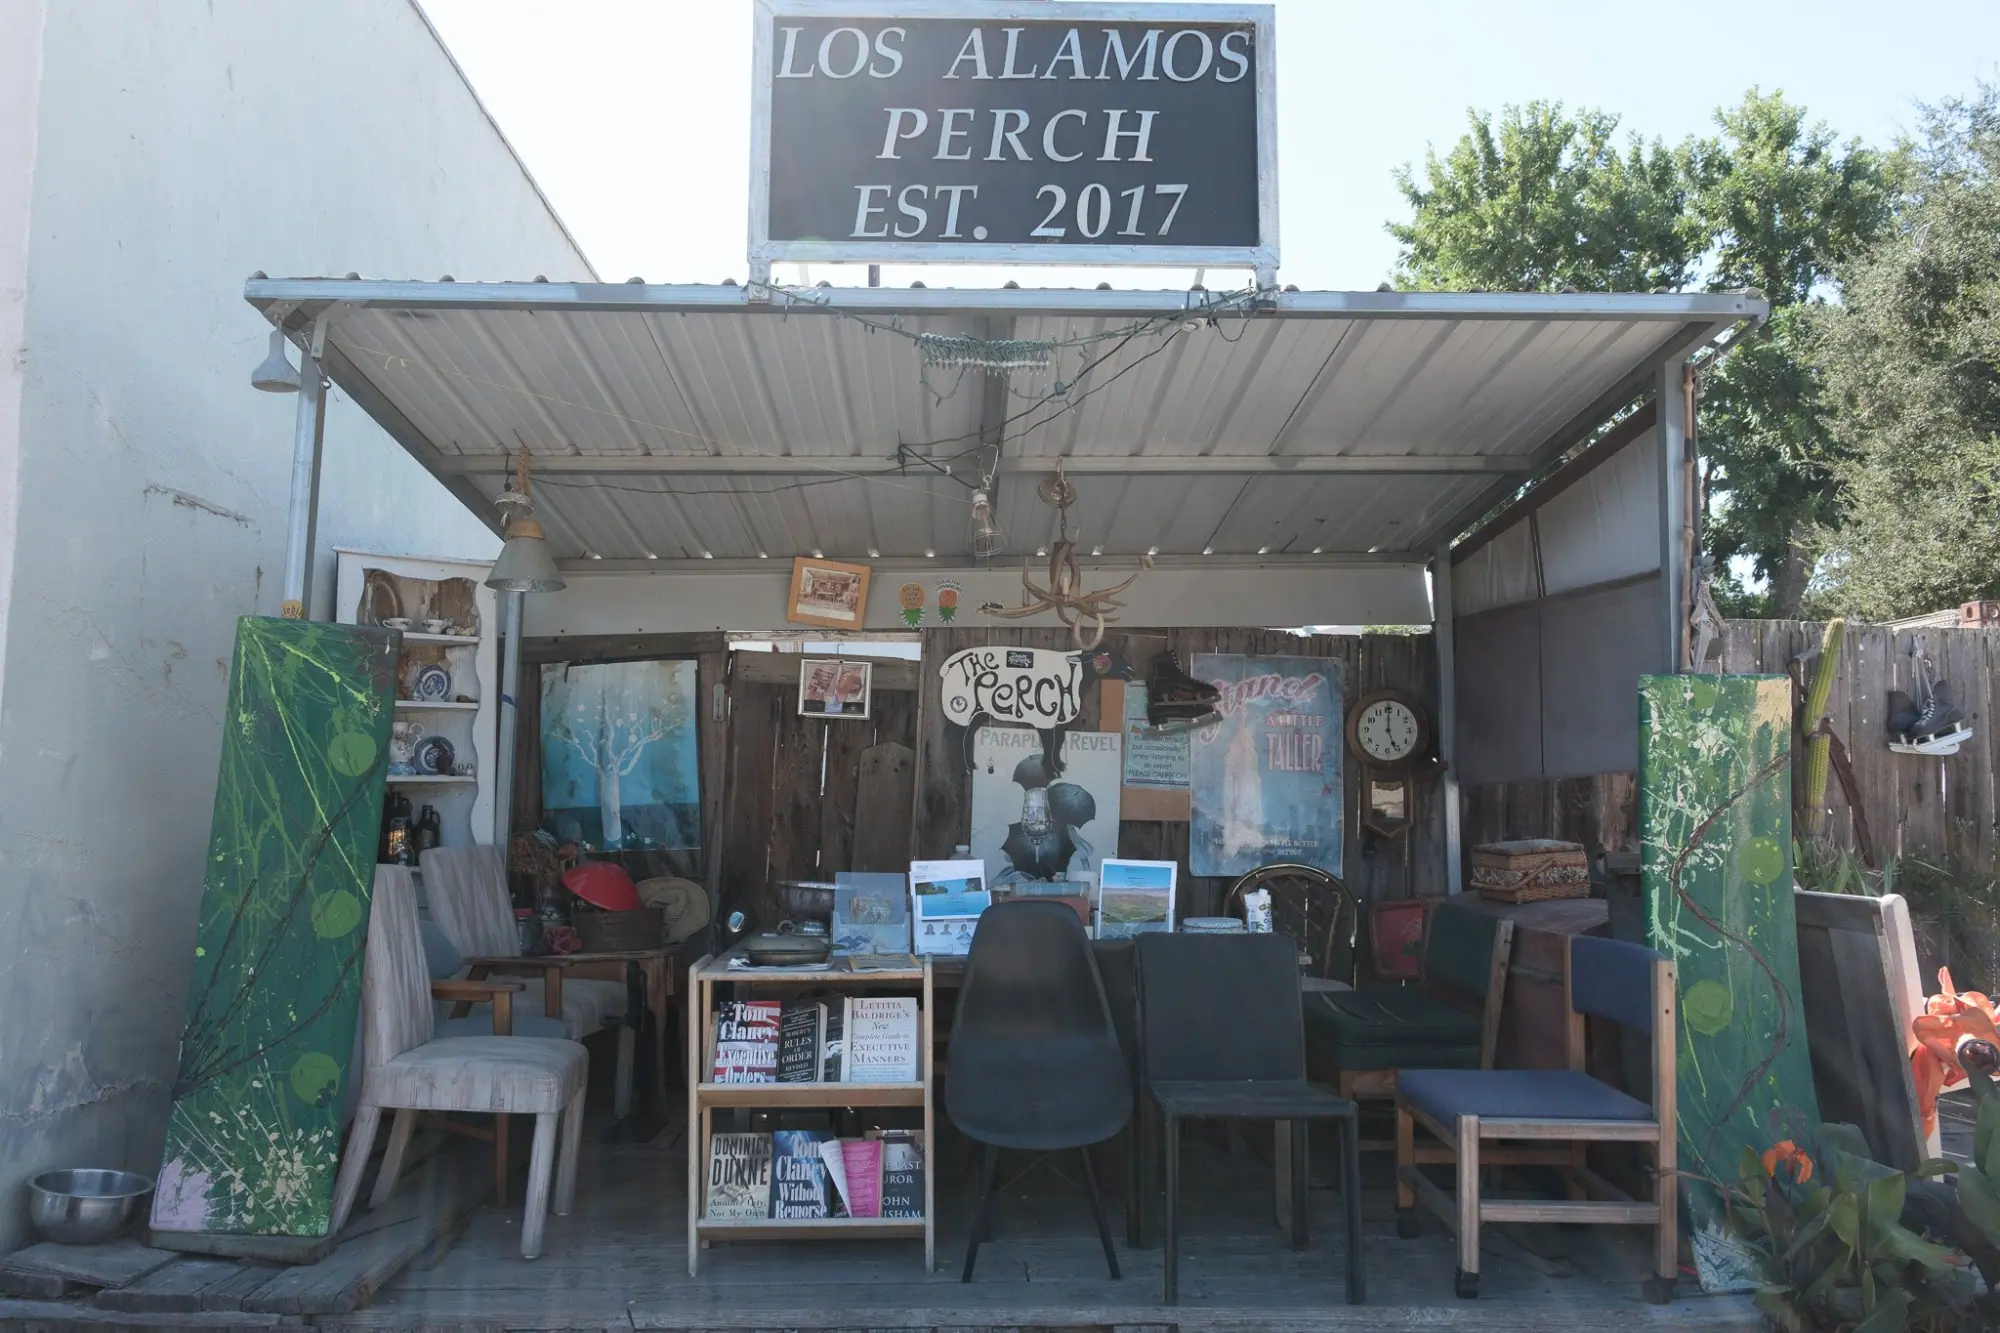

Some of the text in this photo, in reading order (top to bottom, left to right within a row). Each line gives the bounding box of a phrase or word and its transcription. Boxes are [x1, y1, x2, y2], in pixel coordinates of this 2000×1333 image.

[776, 26, 1253, 84] LOS ALAMOS
[875, 107, 1161, 163] PERCH
[848, 183, 1189, 242] EST. 2017
[1278, 714, 1324, 727] LITTLE
[1069, 732, 1117, 752] REVEL
[1144, 744, 1182, 753] occasionally
[1266, 732, 1323, 772] TALLER
[1152, 770, 1175, 779] CARRY
[732, 1003, 768, 1021] Tom
[860, 1000, 902, 1010] LETITIA
[852, 1009, 910, 1020] BALDRIGE'S
[719, 1020, 776, 1044] Clancy
[872, 1022, 889, 1030] New
[784, 1036, 812, 1049] RULES
[851, 1041, 911, 1052] EXECUTIVE
[719, 1043, 775, 1066] Executive
[781, 1050, 813, 1064] ORDER
[854, 1053, 906, 1063] MANNERS
[724, 1066, 767, 1083] Orders
[714, 1136, 770, 1156] DOMINICK
[791, 1134, 822, 1158] Tom
[712, 1157, 770, 1187] DUNNE
[775, 1155, 827, 1184] Clancy
[710, 1199, 743, 1207] Another
[775, 1200, 828, 1219] Remorse
[883, 1196, 910, 1206] OHN
[709, 1208, 765, 1219] Not My Own
